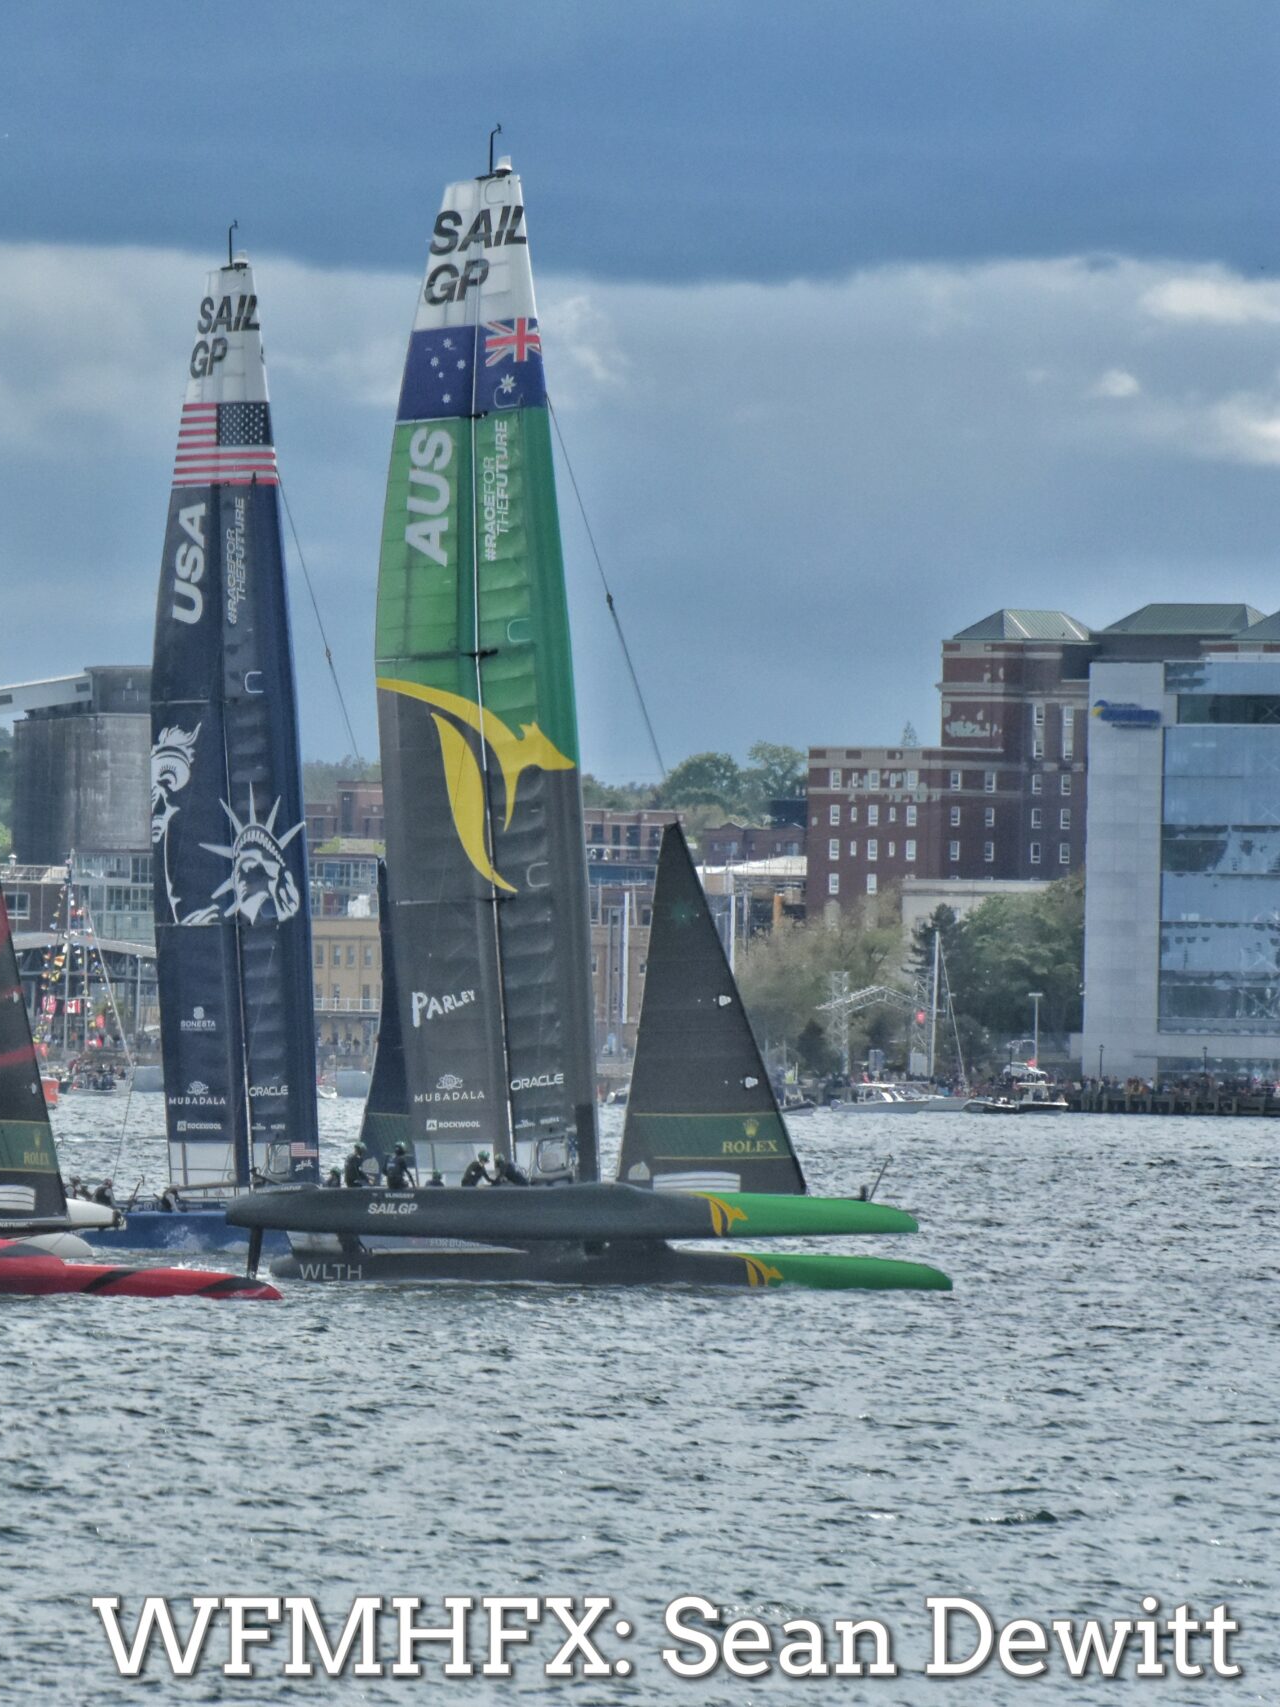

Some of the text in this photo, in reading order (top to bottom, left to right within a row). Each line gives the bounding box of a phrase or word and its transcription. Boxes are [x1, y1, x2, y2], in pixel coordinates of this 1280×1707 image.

[429, 205, 526, 256] SAIL
[424, 258, 489, 306] GP
[197, 294, 260, 334] SAIL
[190, 337, 228, 379] GP
[405, 426, 453, 568] AUS
[495, 419, 509, 536] THEFUTURE
[483, 456, 497, 561] #RACEFOR
[171, 502, 206, 625] USA
[234, 496, 246, 603] THEFUTURE
[226, 527, 239, 625] #RACEFOR
[411, 989, 475, 1028] PARLEY
[168, 1097, 226, 1105] MUBADALA
[248, 1085, 289, 1097] ORACLE
[414, 1091, 485, 1102] MUBADALA
[510, 1073, 564, 1091] ORACLE
[438, 1120, 480, 1128] ROCKWOOL
[23, 1151, 50, 1166] ROLEX
[722, 1140, 778, 1153] ROLEX
[299, 1263, 362, 1280] WLTH
